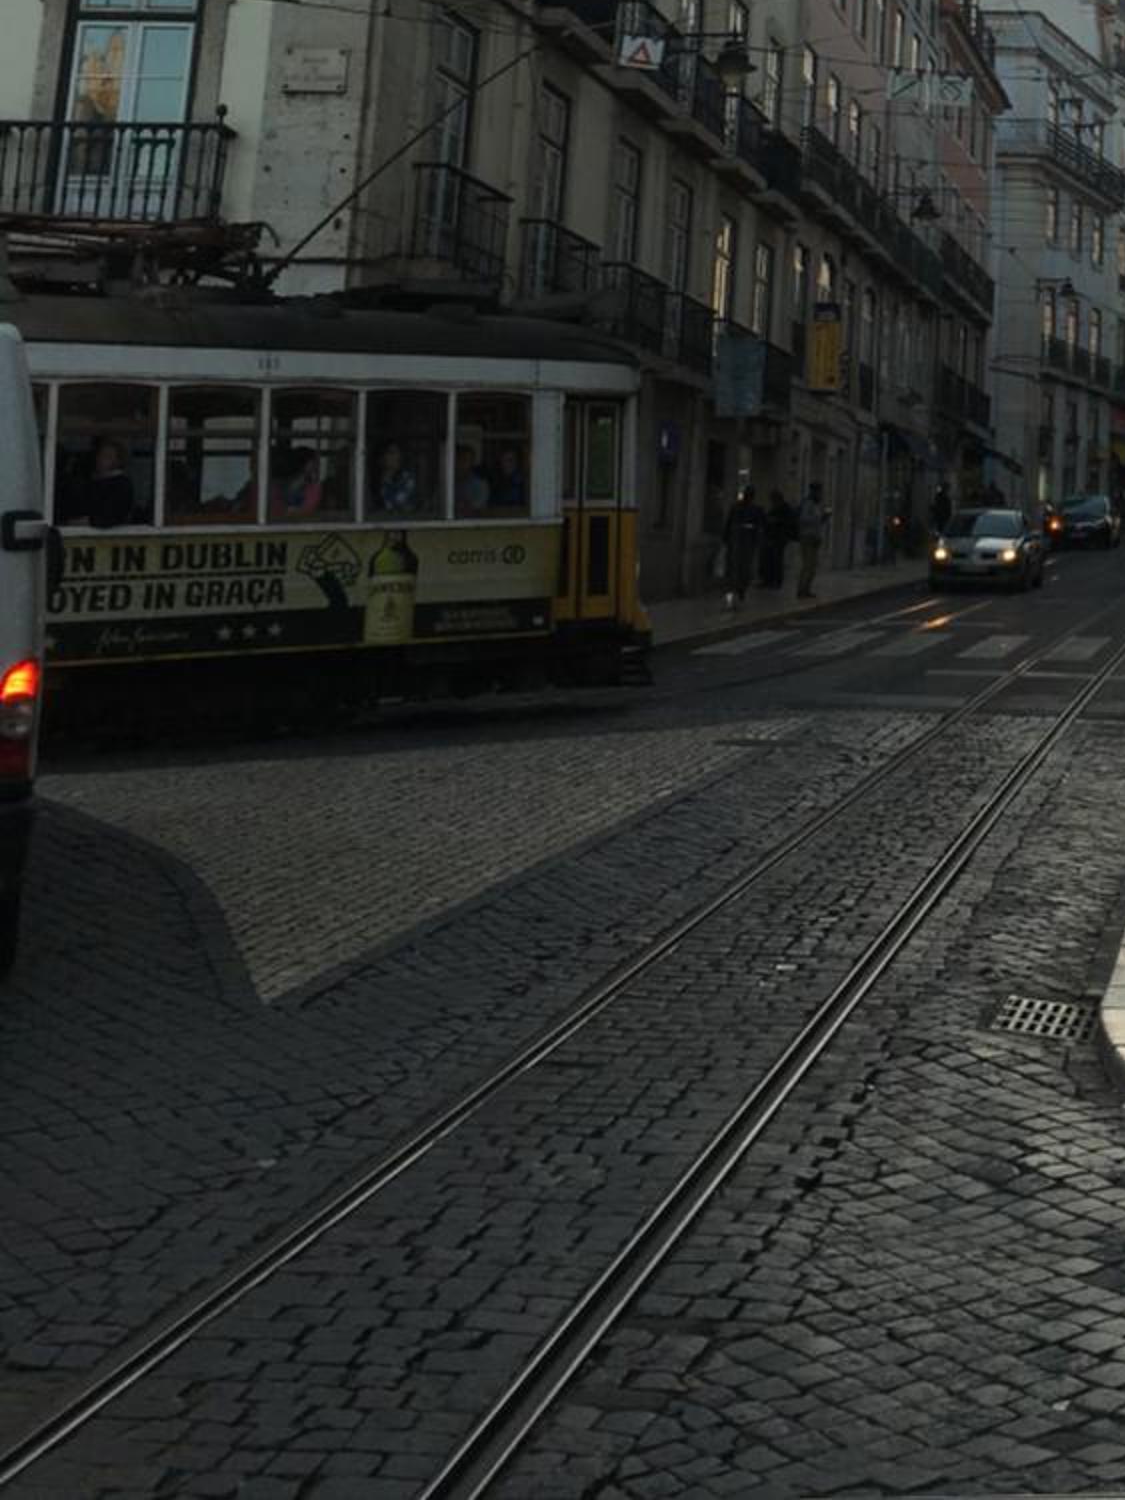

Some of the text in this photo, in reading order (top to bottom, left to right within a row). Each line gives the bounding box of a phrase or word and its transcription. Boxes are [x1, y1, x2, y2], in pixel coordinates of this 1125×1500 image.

[110, 545, 146, 572] IN
[161, 540, 288, 571] DUBLIN
[143, 582, 176, 610] IN
[185, 577, 285, 610] GRAÇA
